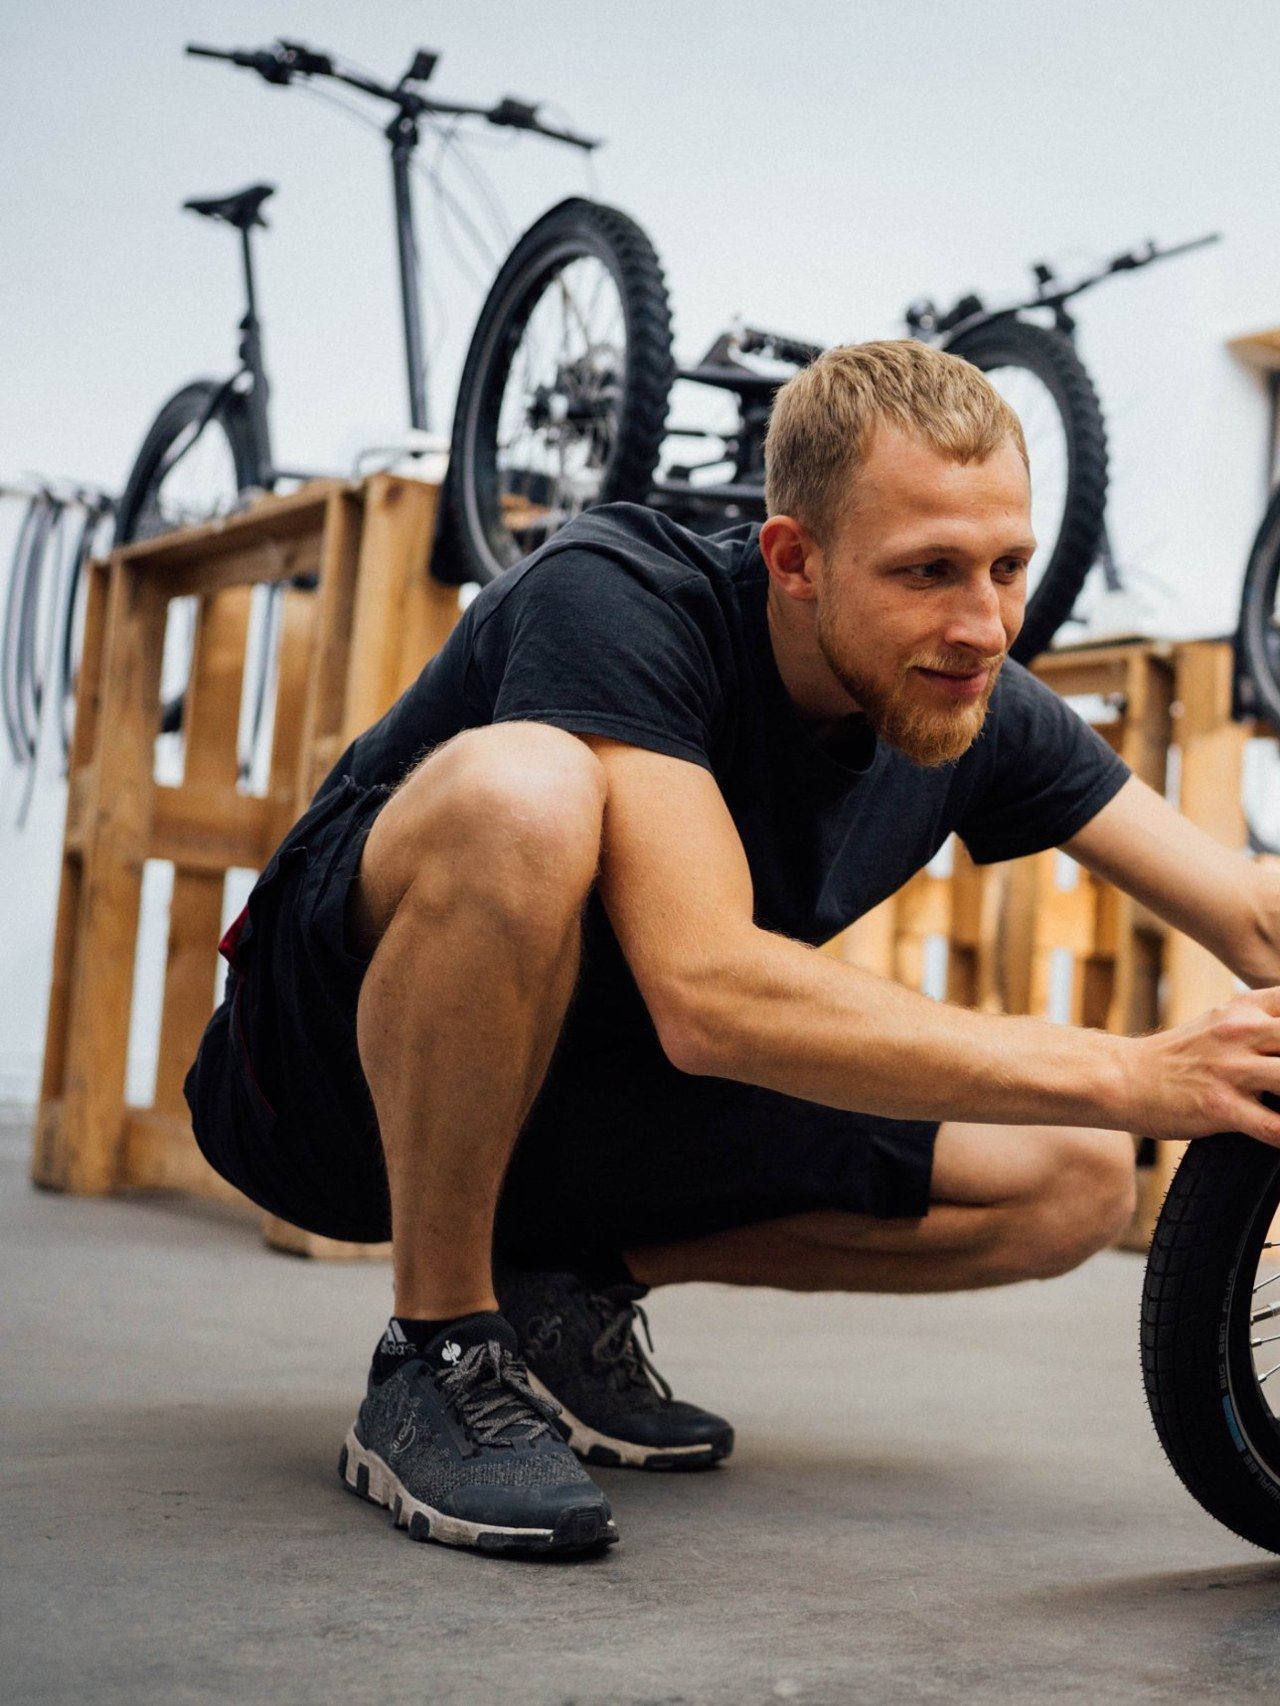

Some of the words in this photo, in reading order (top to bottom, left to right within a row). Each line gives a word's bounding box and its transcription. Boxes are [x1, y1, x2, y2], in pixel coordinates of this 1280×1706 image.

[1222, 1268, 1235, 1312] PLUS
[380, 1340, 417, 1356] idas
[1218, 1363, 1228, 1390] BIG
